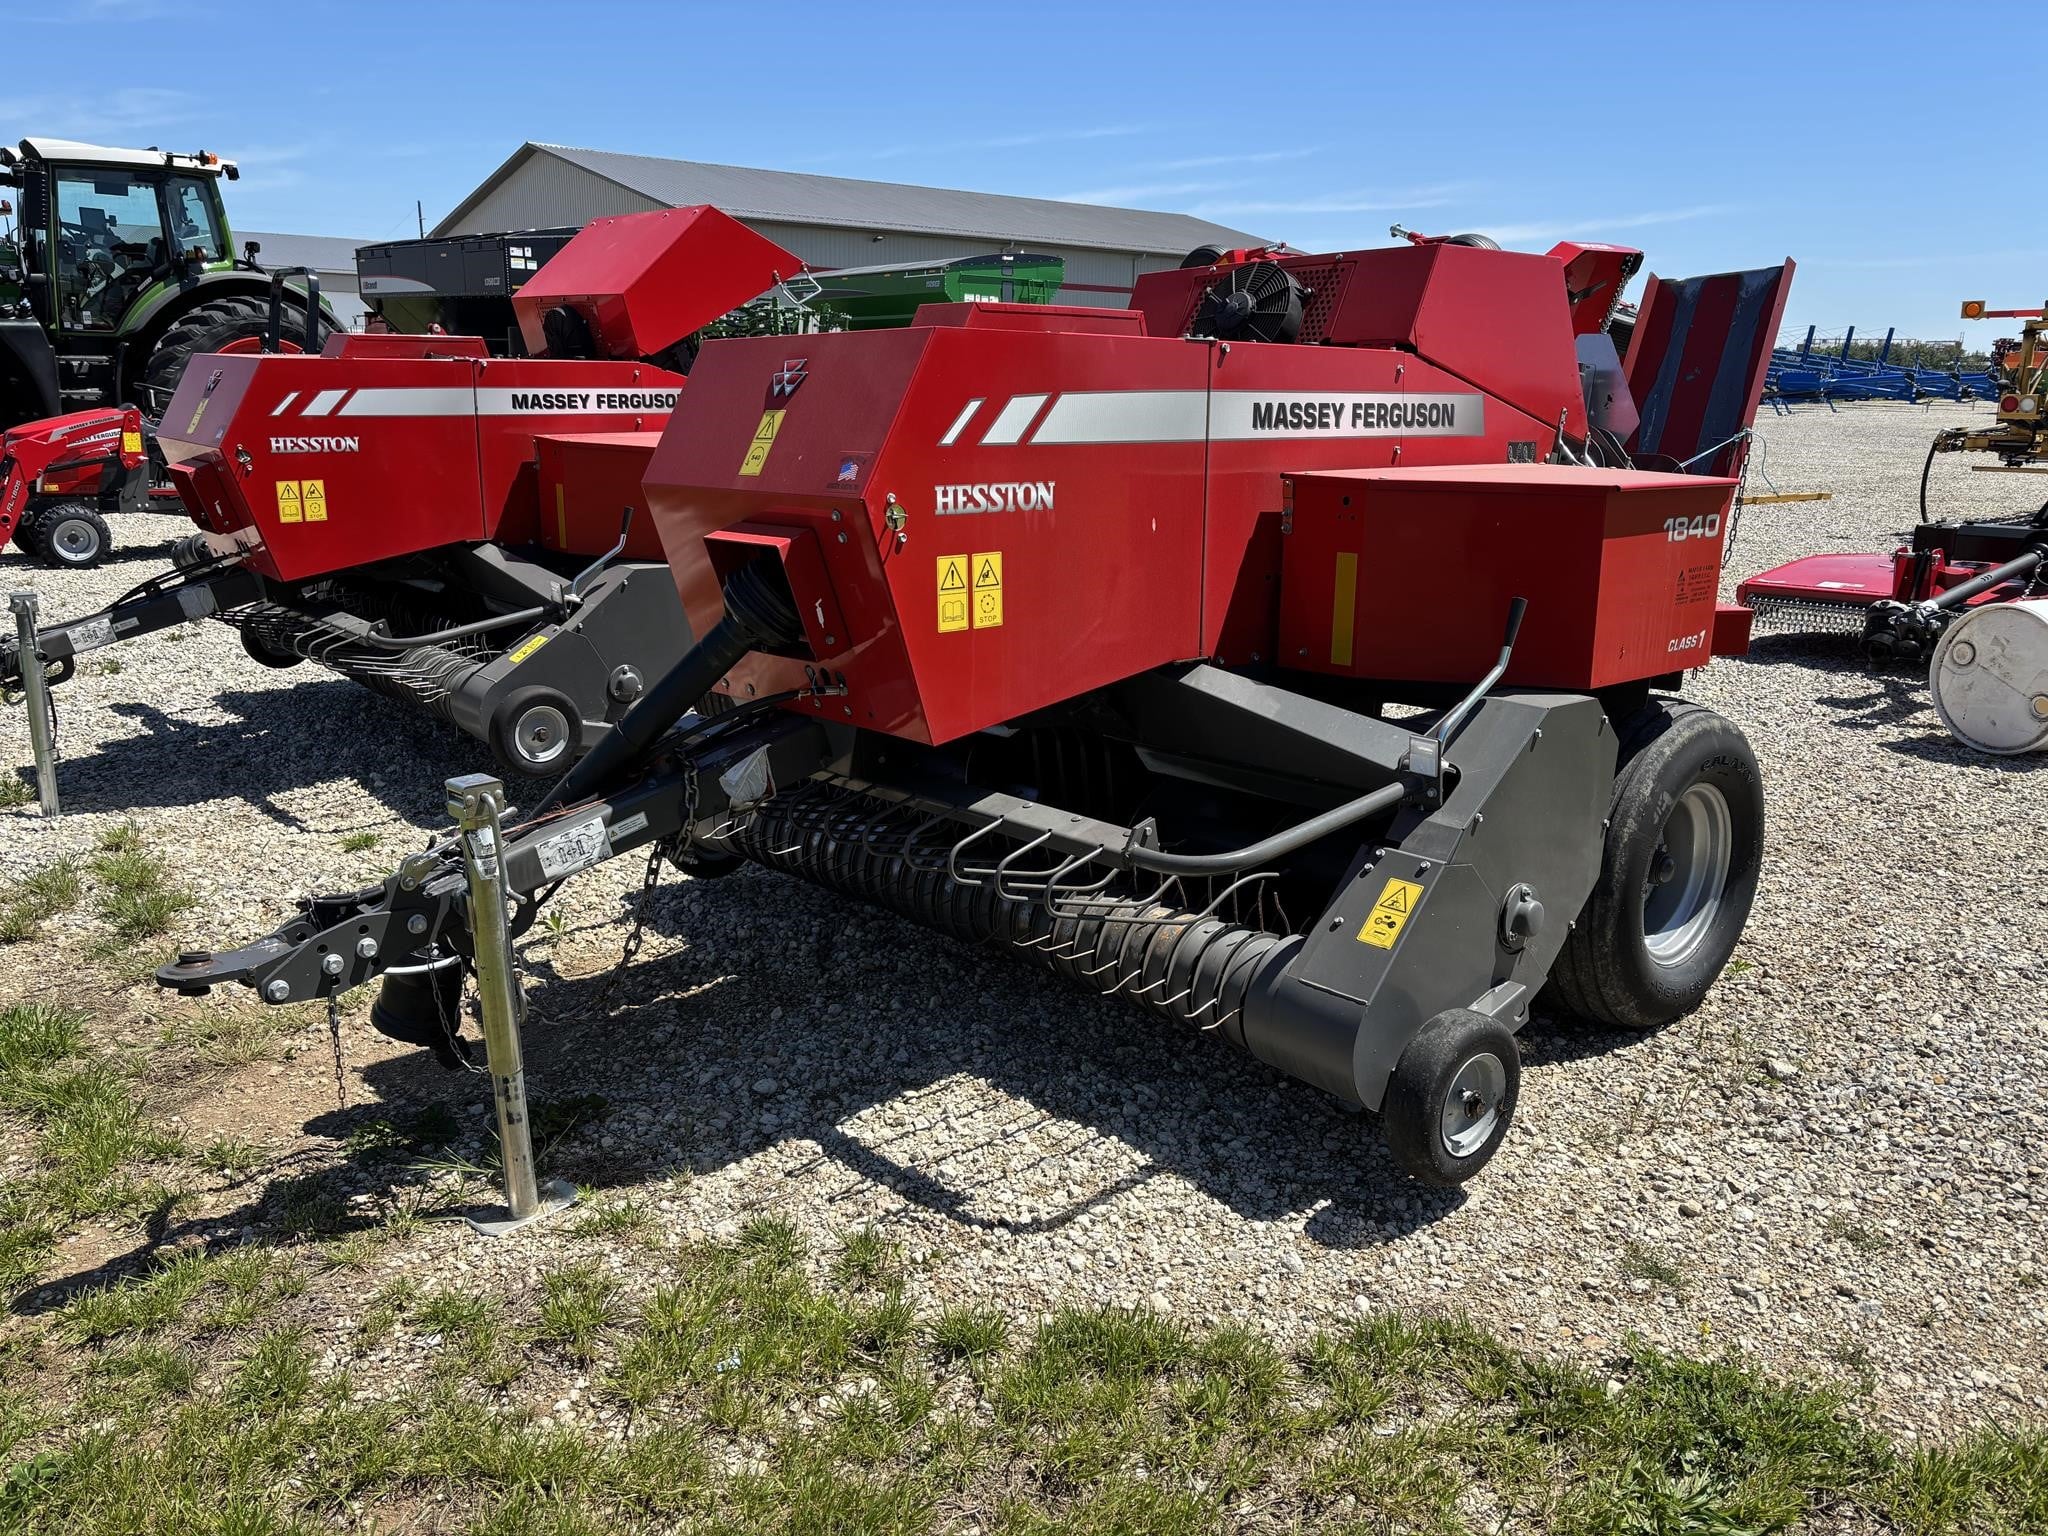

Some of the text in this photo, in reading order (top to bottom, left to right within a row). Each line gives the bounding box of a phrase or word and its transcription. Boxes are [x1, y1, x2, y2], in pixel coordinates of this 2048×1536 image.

[512, 394, 681, 410] MASSEY FERGUSO
[1252, 402, 1456, 430] MASSEY FERGUSON
[93, 430, 121, 440] FERGUSO
[269, 436, 360, 454] HESSTON
[934, 481, 1056, 516] HESSTON
[1663, 513, 1721, 542] 1840
[979, 614, 998, 624] STOP
[1667, 629, 1707, 653] CLASS 1
